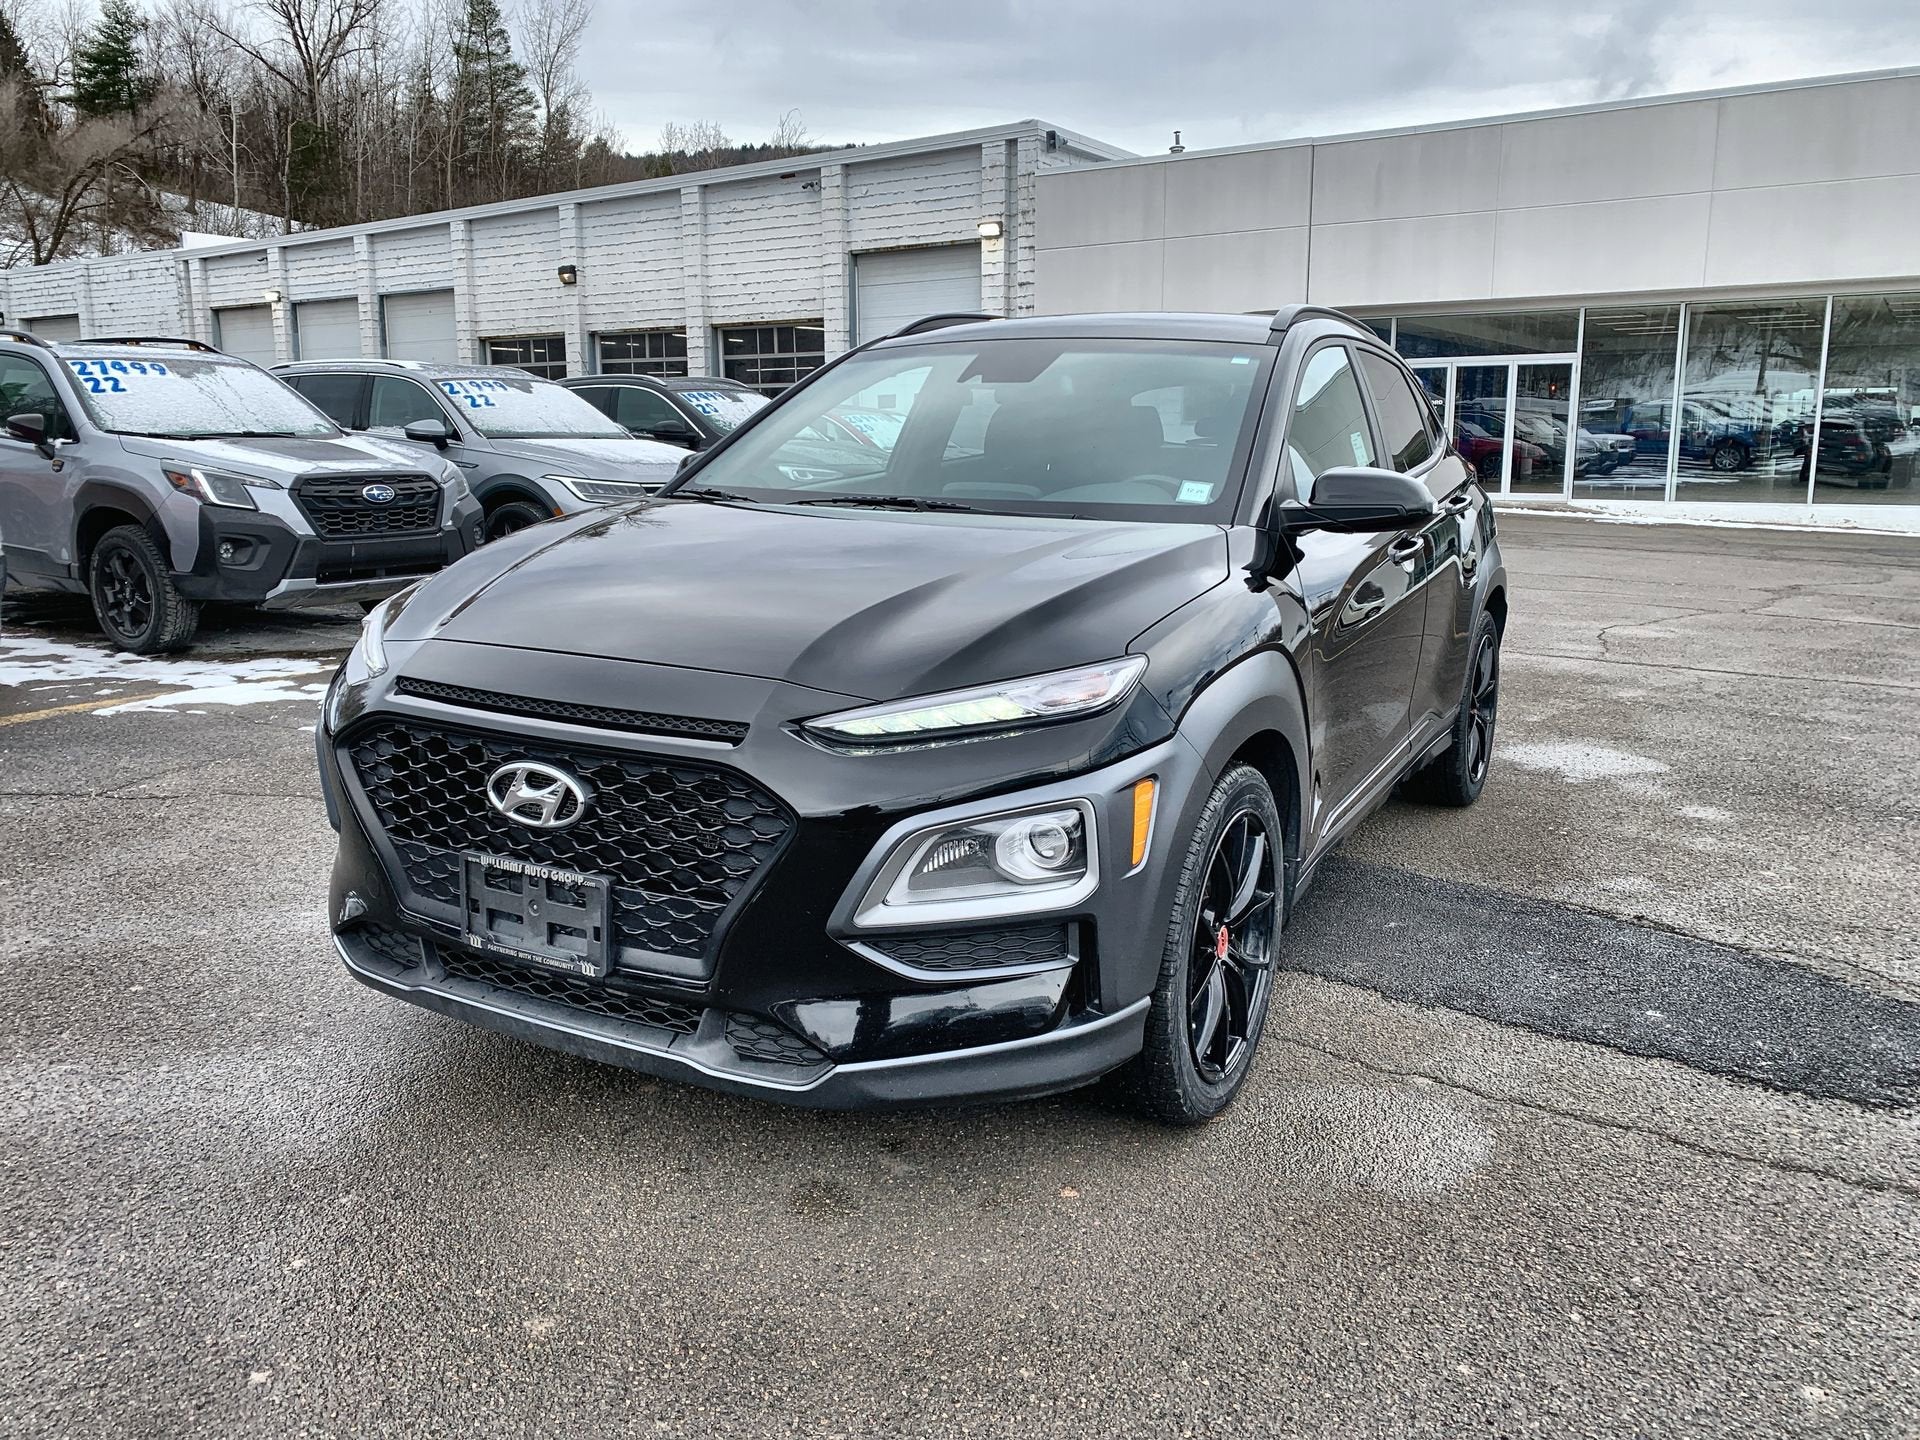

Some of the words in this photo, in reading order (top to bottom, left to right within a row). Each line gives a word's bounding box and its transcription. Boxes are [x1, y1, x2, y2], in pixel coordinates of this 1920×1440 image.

[83, 376, 127, 393] 22
[441, 381, 508, 395] 21999
[463, 394, 495, 408] 22
[695, 402, 719, 414] 20
[525, 865, 548, 879] AUTO
[488, 944, 517, 957] PARTNERING
[518, 952, 532, 960] WITH
[532, 955, 542, 963] THE
[543, 958, 574, 970] COMMUNITY
